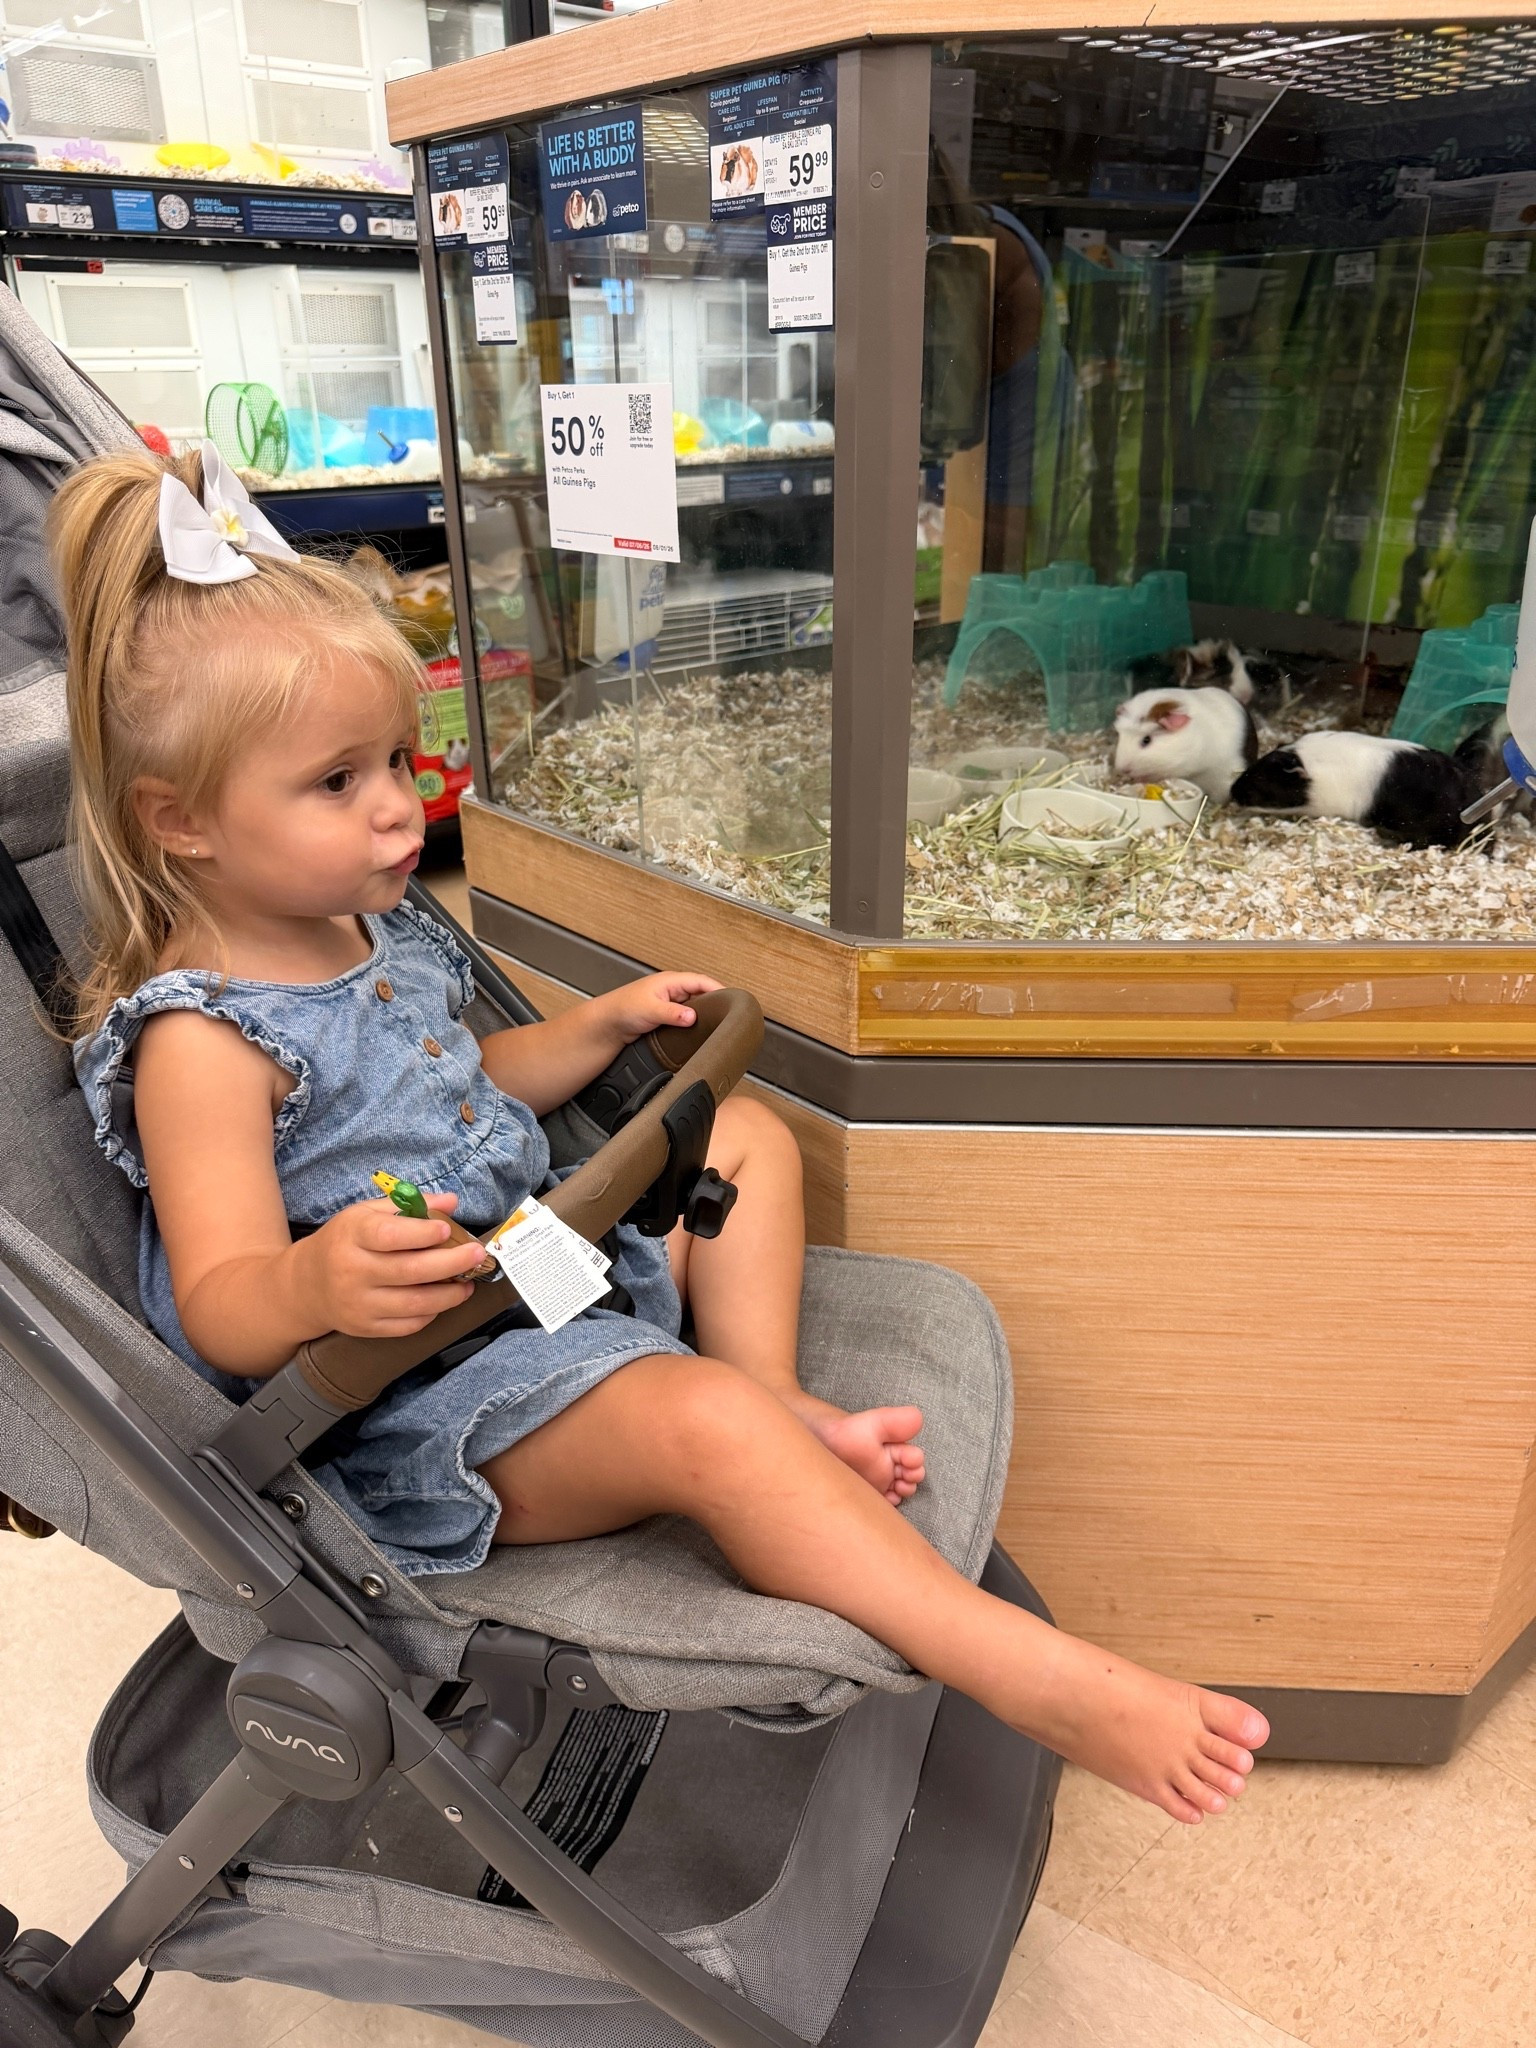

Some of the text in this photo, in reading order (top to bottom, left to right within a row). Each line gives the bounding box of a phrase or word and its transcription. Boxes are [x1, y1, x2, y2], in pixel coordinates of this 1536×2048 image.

[710, 88, 730, 100] SUPER
[732, 85, 742, 96] PET
[743, 79, 767, 93] GUINEA
[768, 75, 780, 86] PIG
[800, 87, 822, 97] ACTIVITY
[757, 97, 777, 106] LIFESPAN
[718, 105, 741, 115] CARE LEVEL
[782, 107, 819, 119] COMPATIBILITY
[548, 120, 635, 156] LIFE IS BETTER
[549, 143, 636, 177] WITH A BUDDY
[790, 153, 814, 187] 59
[815, 151, 828, 167] 99
[557, 181, 567, 189] thrive
[615, 171, 625, 179] learn
[214, 206, 239, 214] SHEETS
[620, 203, 639, 216] petco
[793, 203, 827, 217] MEMBER
[72, 212, 86, 223] 23
[482, 205, 498, 230] 59
[794, 214, 827, 233] PRICE
[486, 245, 507, 254] MEMBER
[769, 250, 777, 261] Buy
[487, 254, 509, 267] PRICE
[547, 391, 557, 401] Buy
[562, 391, 571, 399] Get
[572, 391, 575, 399] 1
[590, 442, 604, 457] off
[553, 476, 596, 490] All Guinea Pigs
[245, 1720, 346, 1764] nuna
[640, 1716, 667, 1765] WARNING
